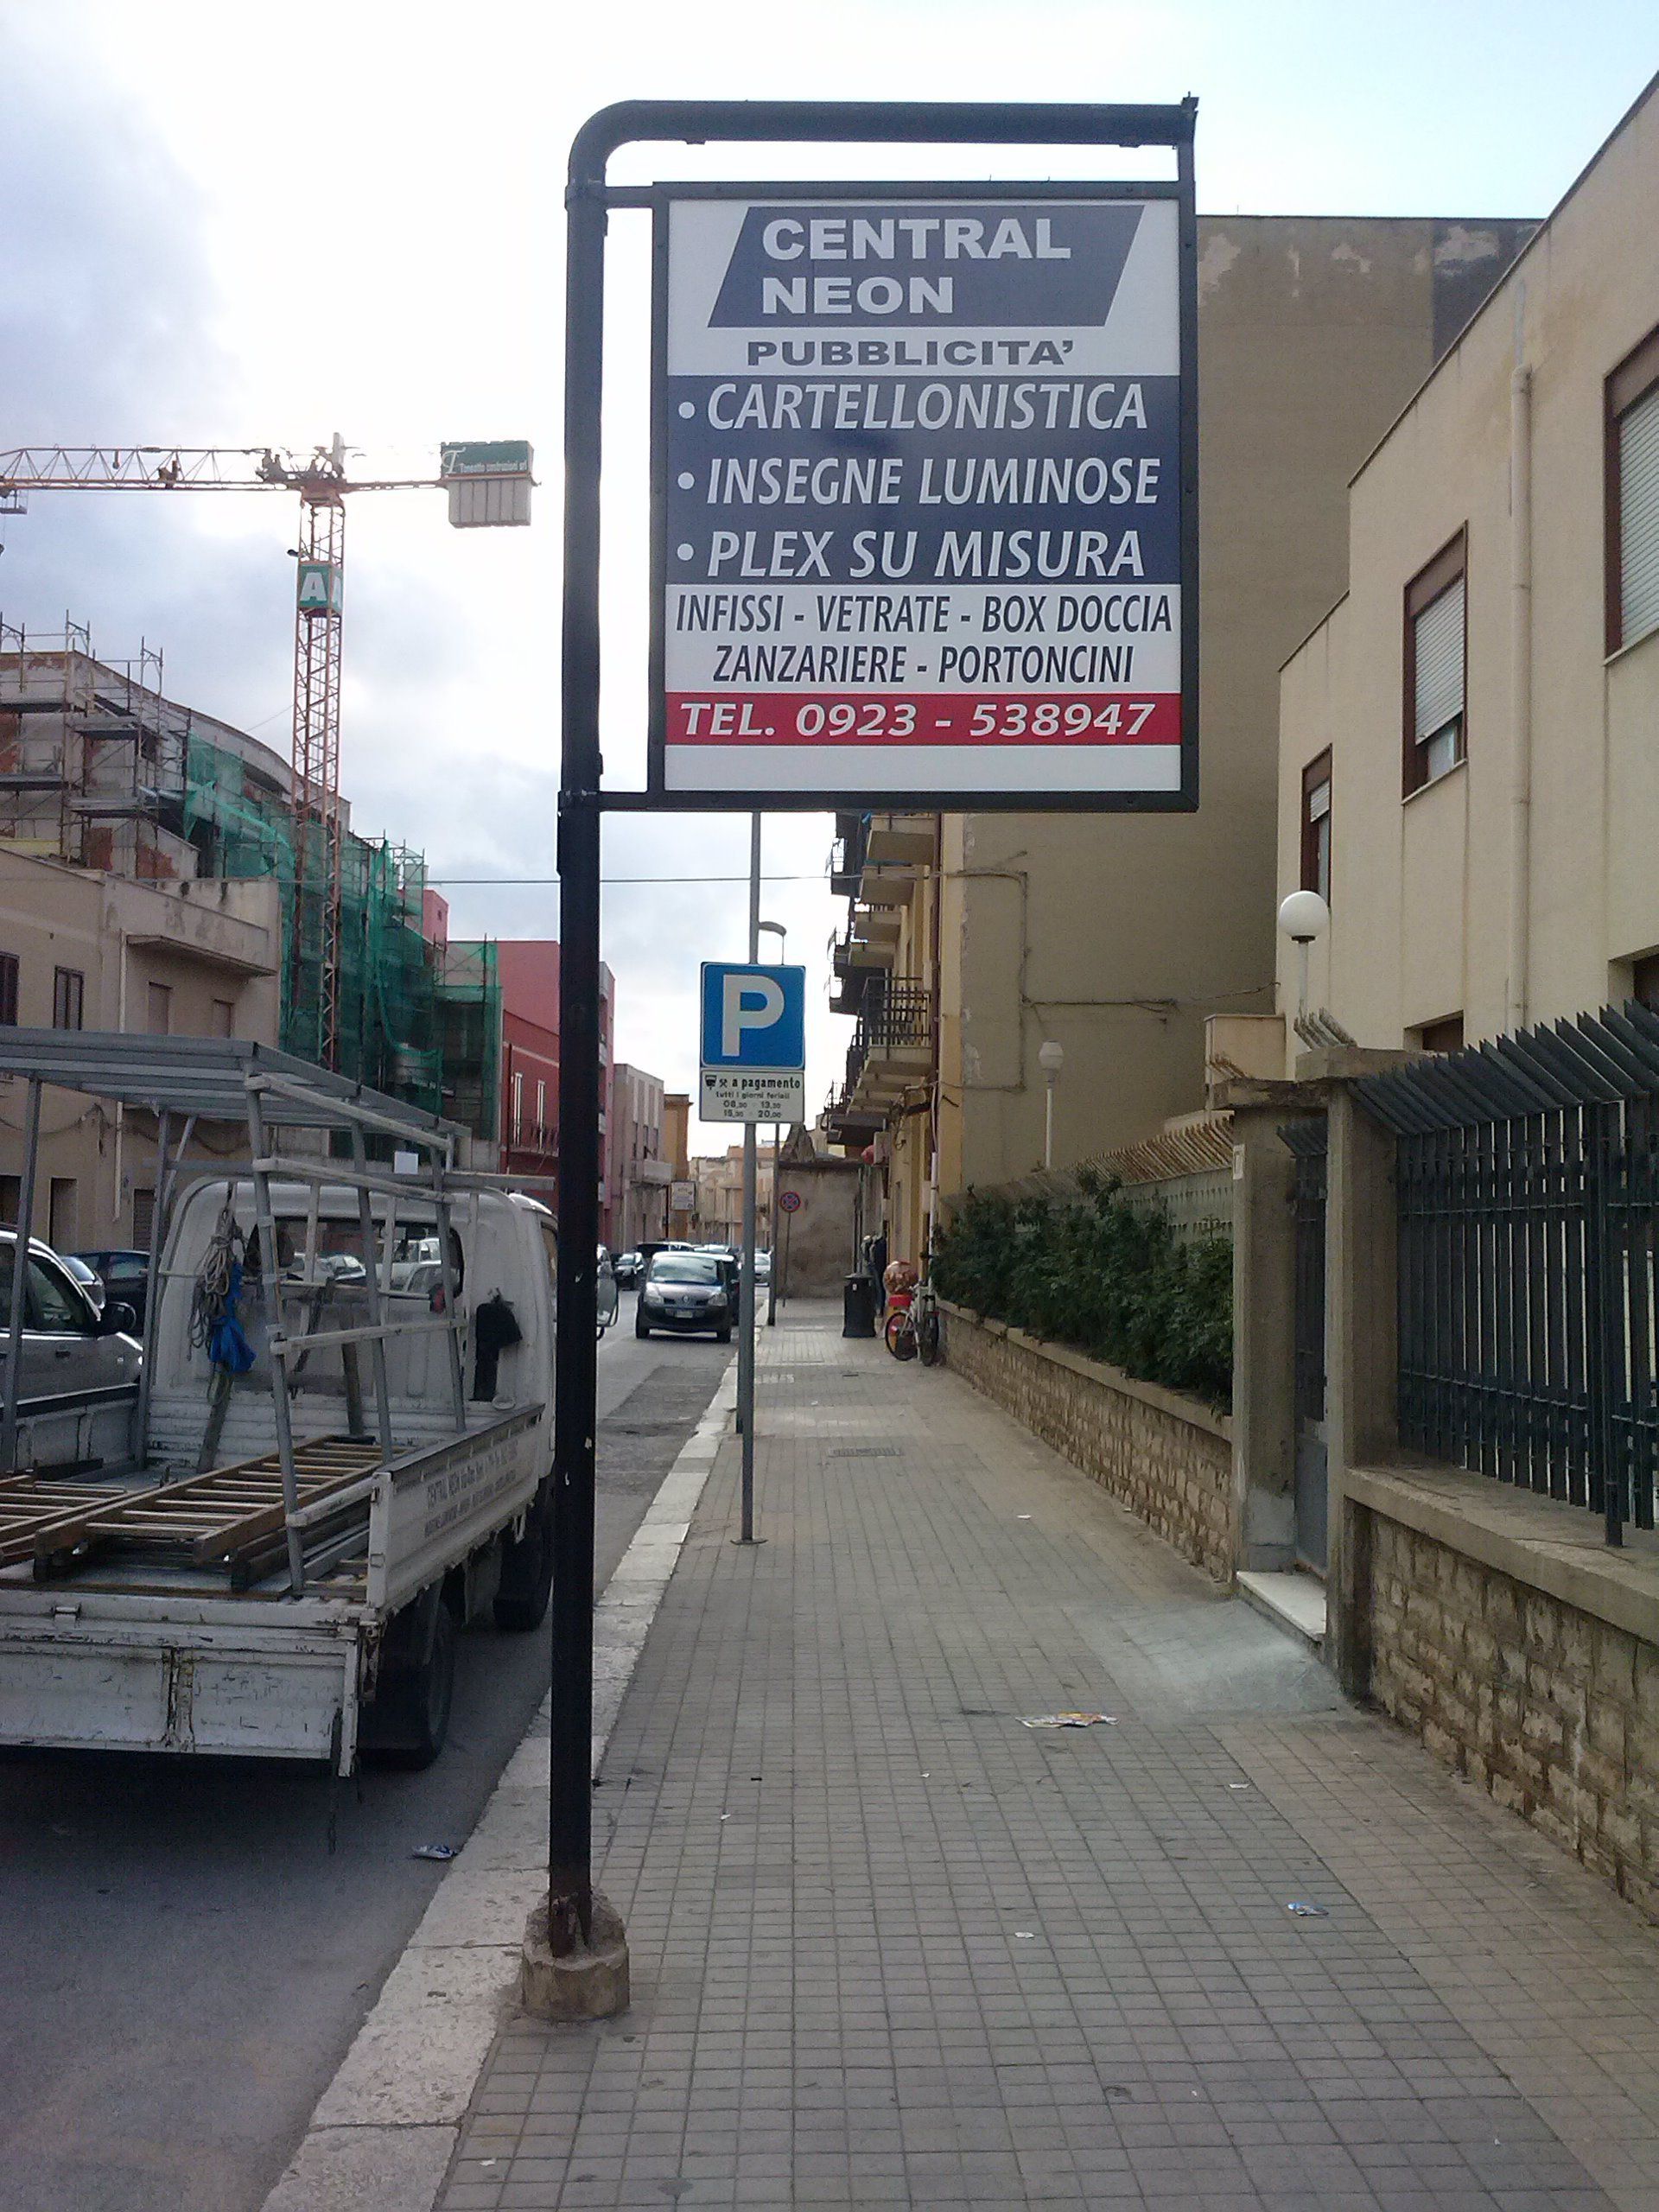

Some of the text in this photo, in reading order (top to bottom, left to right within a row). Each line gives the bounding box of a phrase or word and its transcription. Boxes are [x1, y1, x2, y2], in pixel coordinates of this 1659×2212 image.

[762, 218, 1071, 260] CENTRAL
[762, 276, 953, 314] NEON
[707, 383, 1147, 430] CARTELLONISTICA
[706, 457, 1160, 505] INSEGNE LUMINOSE
[707, 530, 1145, 578] PLEX SU MISURA
[676, 594, 785, 632] INFISSI
[817, 594, 950, 632] VETRATE
[982, 594, 1047, 632] BOX
[1057, 594, 1173, 632] DOCCIA
[713, 645, 906, 683] ZANZARIERE
[938, 645, 1135, 683] PORTONCINI
[680, 702, 775, 737] TEL.
[796, 702, 917, 737] 0923
[969, 702, 1156, 737] 538947
[721, 974, 785, 1057] P
[732, 1076, 801, 1090] a pagamento
